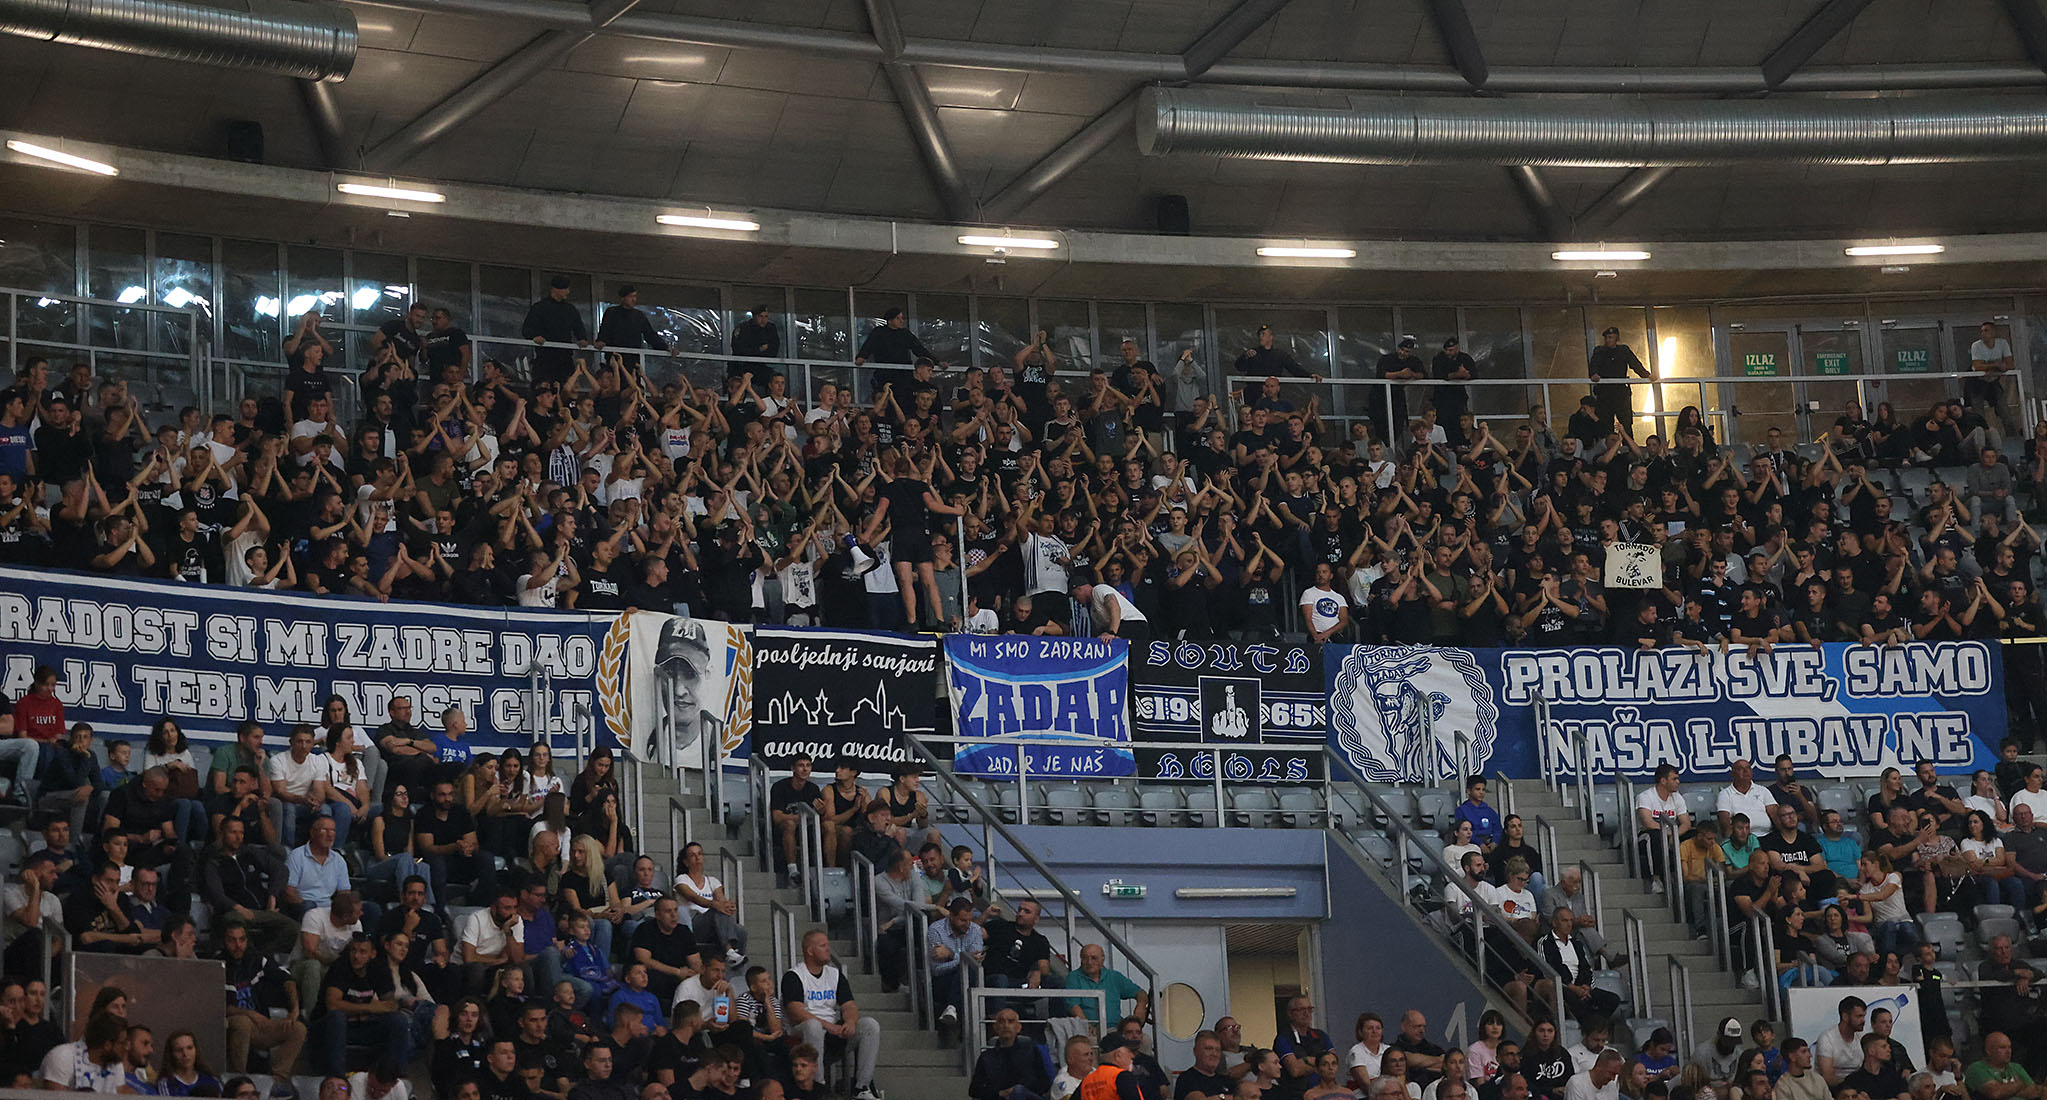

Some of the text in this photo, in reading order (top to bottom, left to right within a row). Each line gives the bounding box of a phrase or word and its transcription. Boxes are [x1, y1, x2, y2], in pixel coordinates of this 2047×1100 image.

[1746, 354, 1775, 365] IZLAZ
[1898, 351, 1926, 362] IZLAZ
[1614, 542, 1655, 555] TORNADO
[590, 580, 619, 595] TORNADO
[1616, 576, 1654, 586] BULEVAR
[0, 592, 595, 679] RADOST SI MI ZADRE DAO
[756, 643, 935, 677] posljednji sanjari
[970, 641, 1112, 660] MI SMO ZADRANI
[1504, 647, 1991, 702] PROLAZI SVE, SAMO
[3, 655, 35, 703] A
[54, 658, 126, 710] JA
[132, 664, 248, 720] TEBI
[254, 675, 483, 731] MLADOST
[952, 664, 1128, 745] ZADAR
[1154, 697, 1313, 726] 19 65
[1545, 711, 1969, 770] NAŠA LJUBAV NE
[1043, 756, 1061, 772] JE
[1071, 749, 1103, 773] NAŠ
[807, 989, 836, 1001] ZADAR
